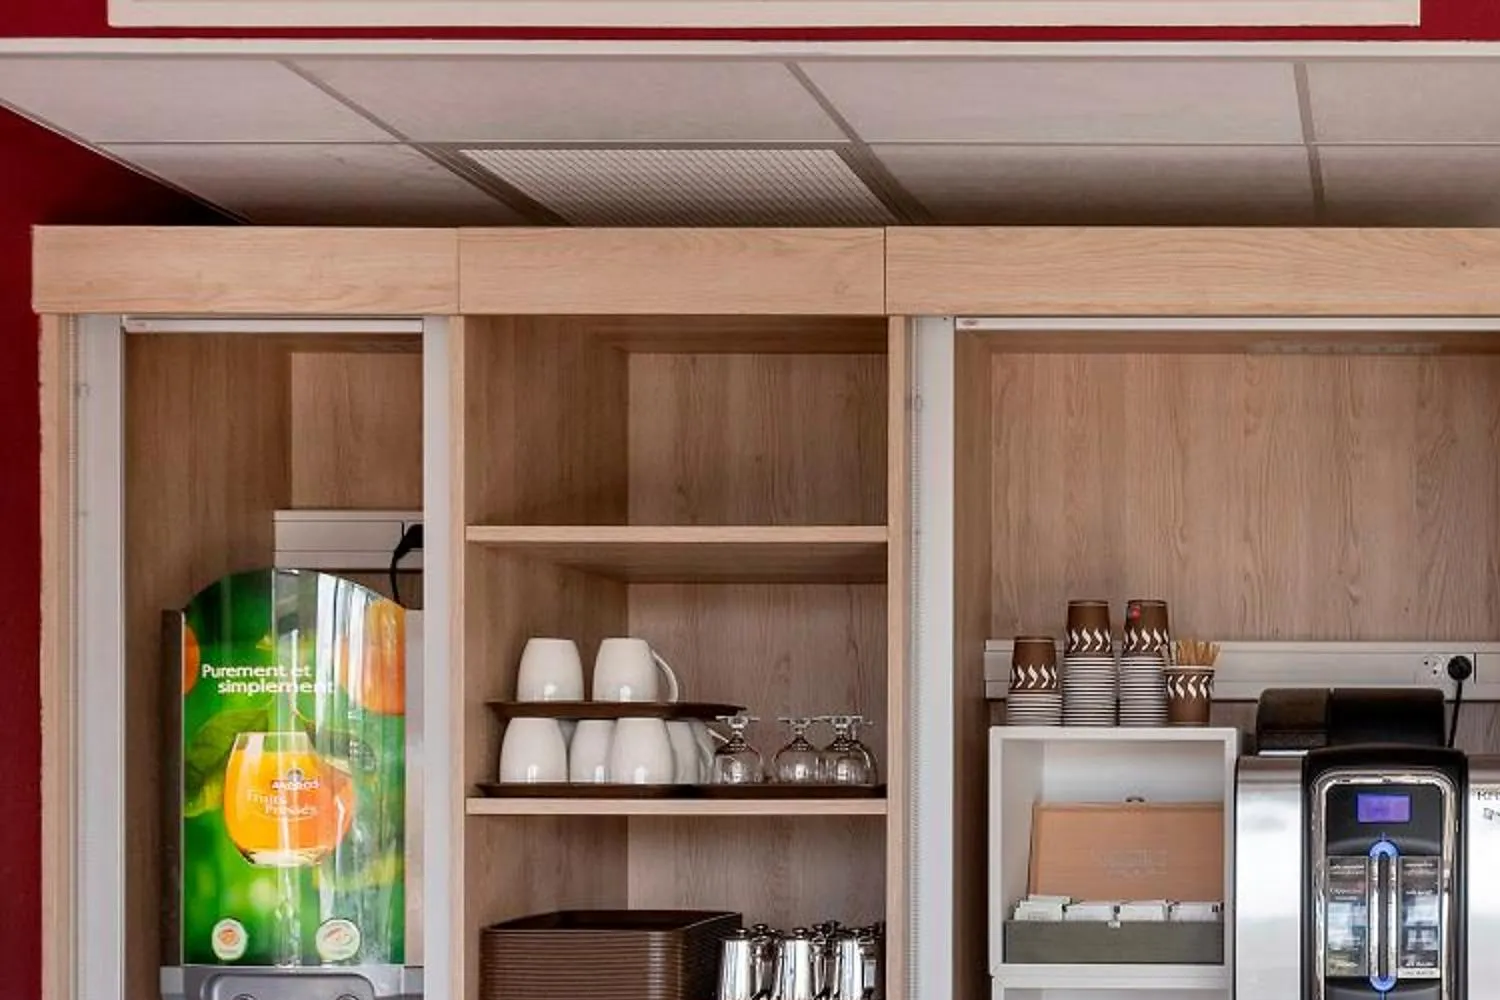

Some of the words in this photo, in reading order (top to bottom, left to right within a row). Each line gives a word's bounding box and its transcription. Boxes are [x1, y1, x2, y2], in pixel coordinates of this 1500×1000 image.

[202, 663, 288, 678] Purement
[292, 664, 312, 678] et
[218, 679, 335, 697] simplemet
